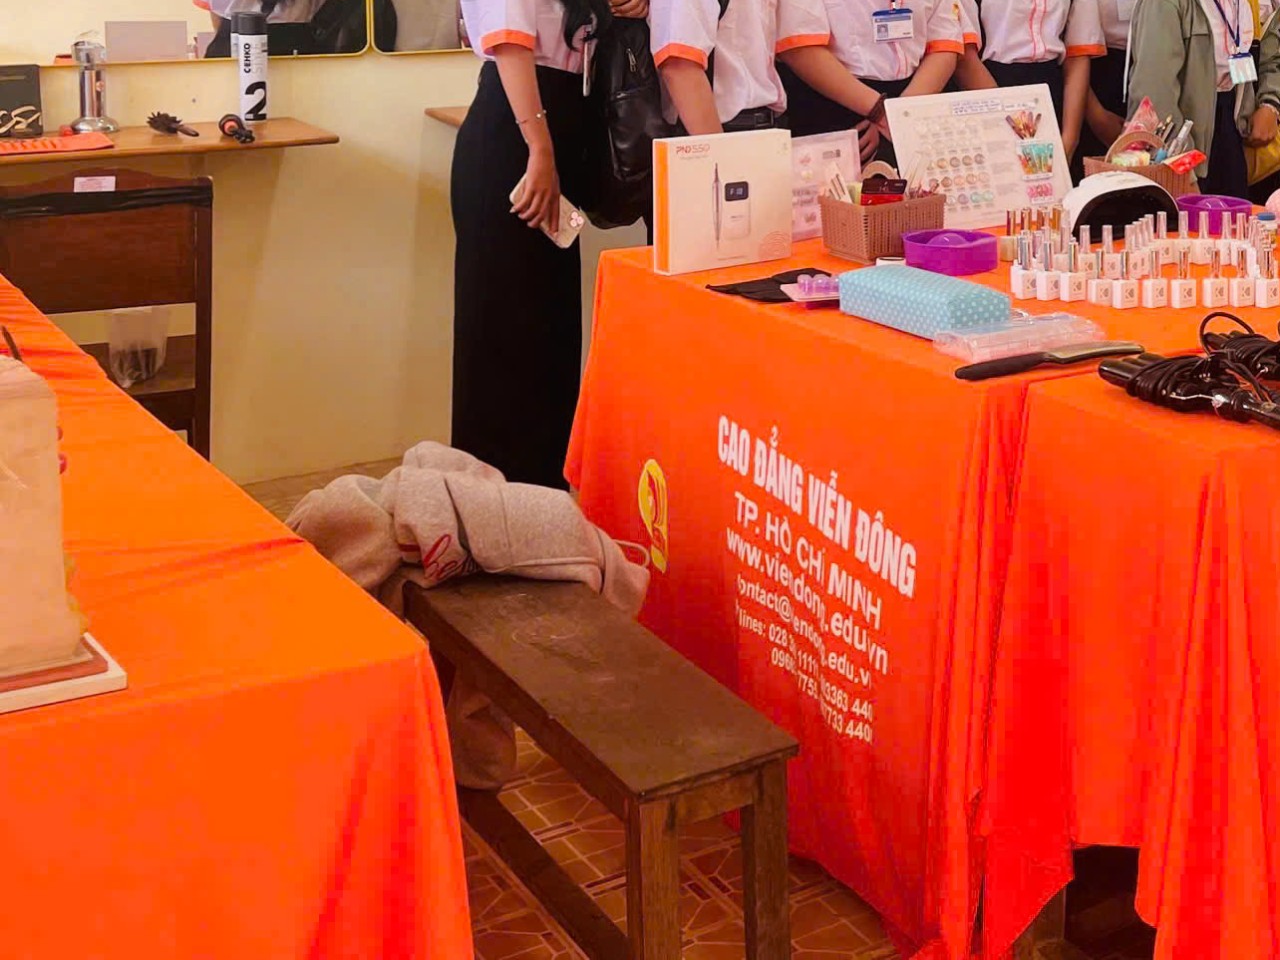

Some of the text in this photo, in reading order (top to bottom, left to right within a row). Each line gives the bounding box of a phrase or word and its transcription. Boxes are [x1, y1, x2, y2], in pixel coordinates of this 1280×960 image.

[718, 415, 917, 599] CAO ĐẲNG VIỄN ĐÔNG
[734, 491, 760, 537] TP.
[828, 562, 882, 630] MINH
[726, 528, 888, 676] www.viedon.eduvn
[768, 623, 788, 647] 028
